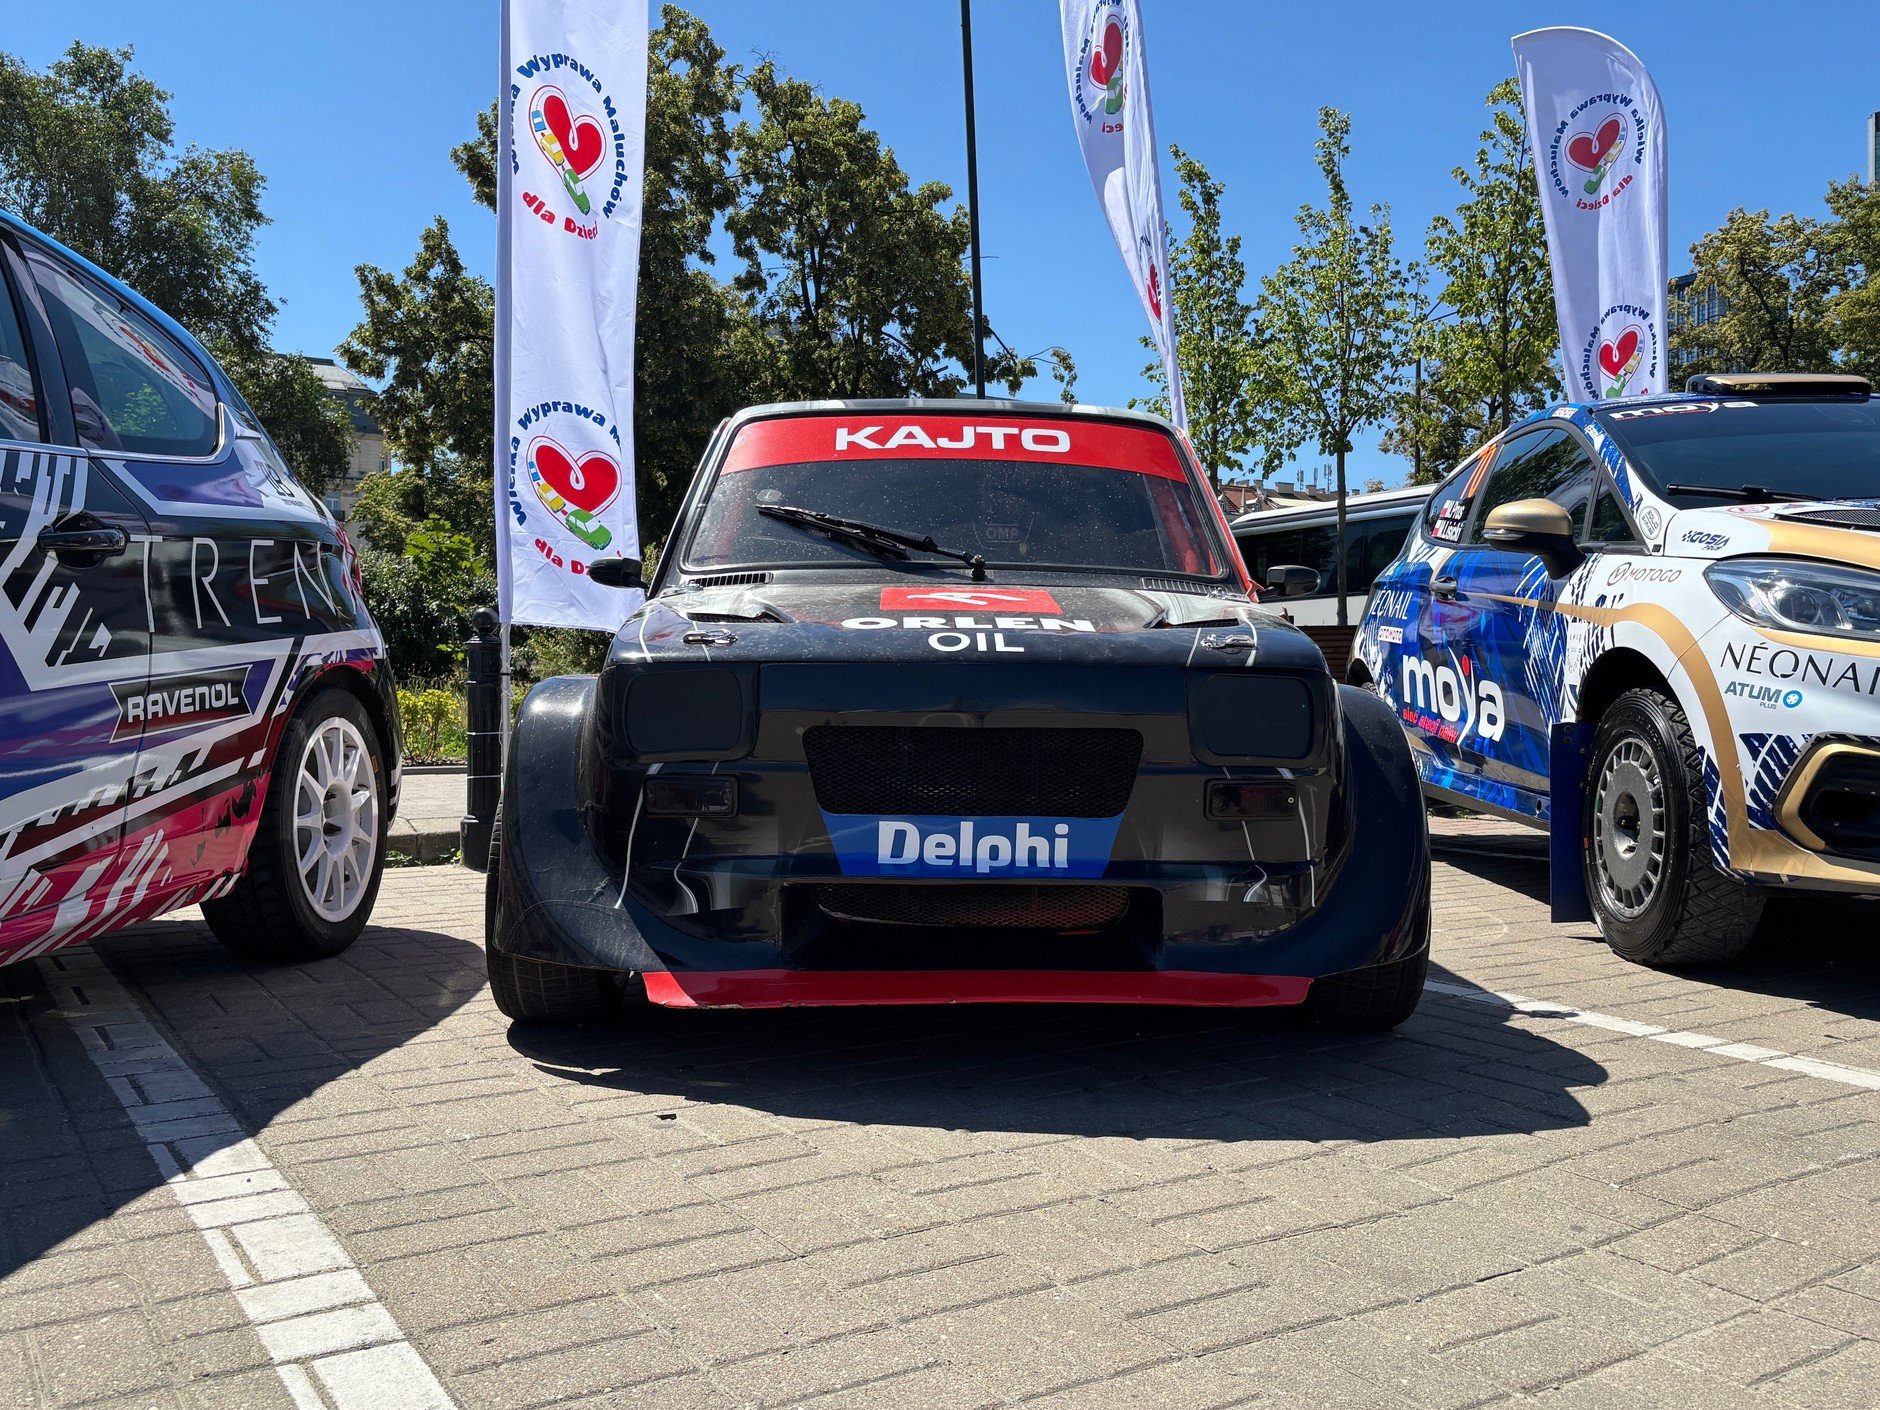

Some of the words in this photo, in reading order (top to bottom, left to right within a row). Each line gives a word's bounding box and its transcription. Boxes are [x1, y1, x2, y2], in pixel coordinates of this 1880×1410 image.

[516, 53, 602, 94] Wyprawa
[602, 95, 628, 219] Maluchów
[522, 191, 556, 225] dla
[564, 217, 598, 240] Dzieci
[518, 400, 606, 432] Wyprawa
[1609, 401, 1759, 422] moya
[835, 425, 1071, 453] KAJTO
[986, 527, 1019, 539] OMP
[534, 538, 563, 569] dla
[840, 616, 1097, 632] ORLEN
[927, 632, 1025, 652] OIL
[127, 683, 239, 723] RAVENOL
[1403, 646, 1505, 746] moya
[1724, 681, 1782, 703] ATUM
[1759, 702, 1777, 710] PLUS
[877, 820, 1069, 873] Delphi
